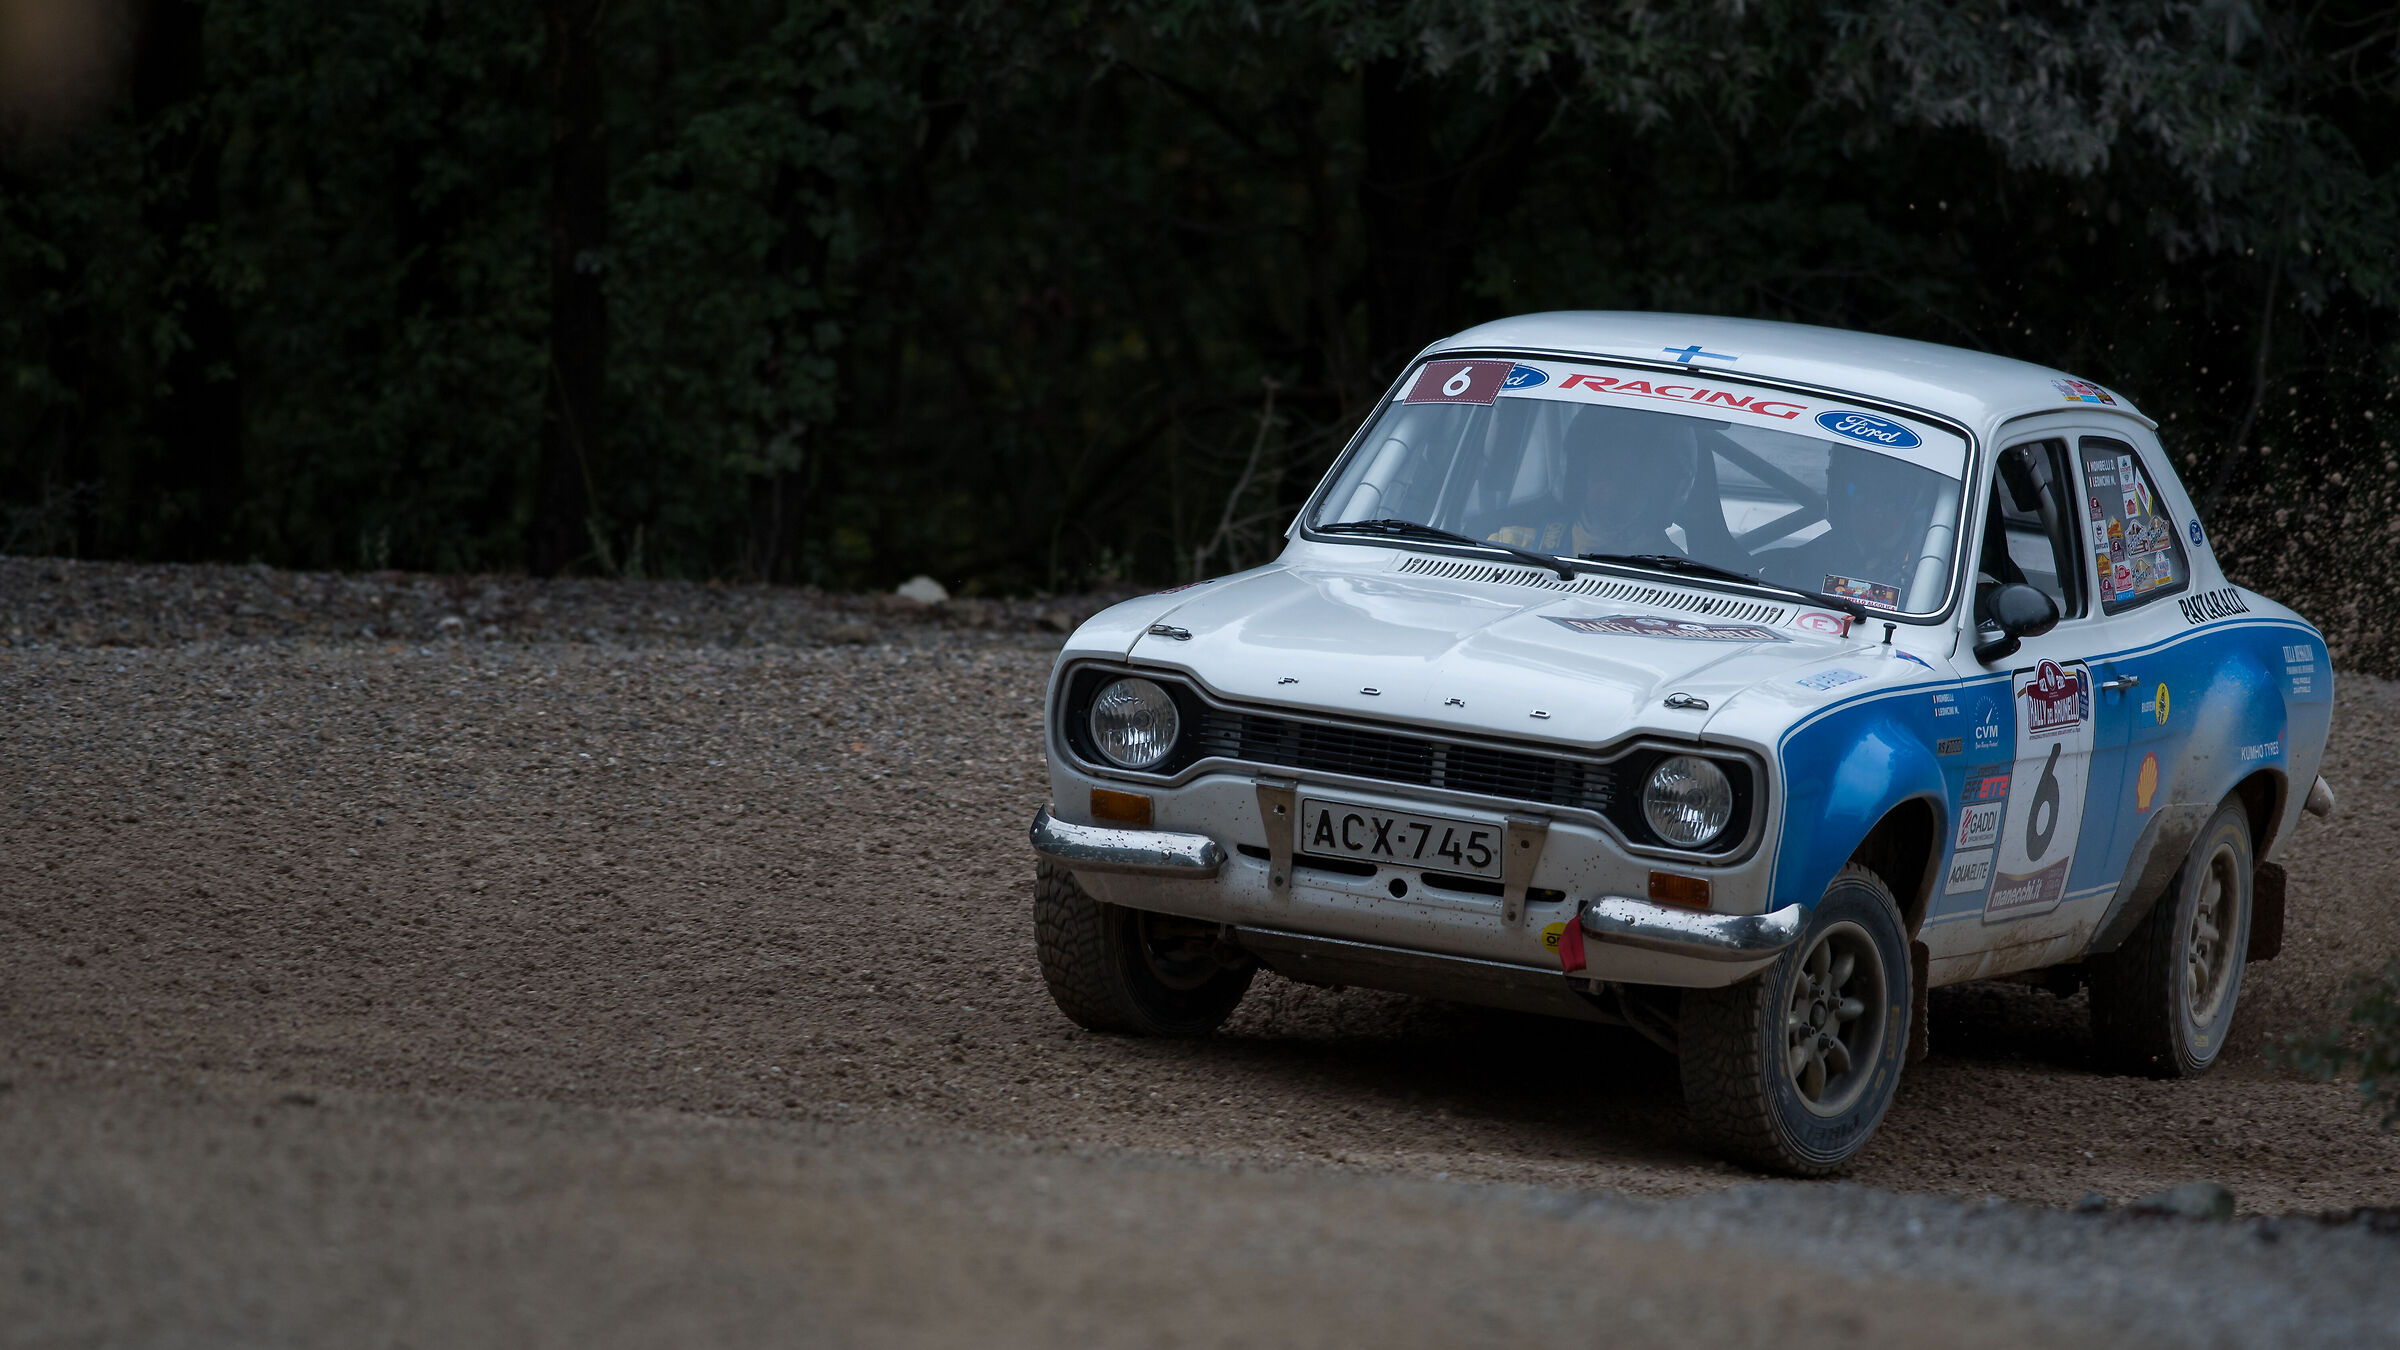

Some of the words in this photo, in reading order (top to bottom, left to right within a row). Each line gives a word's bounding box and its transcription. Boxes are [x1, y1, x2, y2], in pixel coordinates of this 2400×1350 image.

[1442, 366, 1473, 397] 6
[1559, 373, 1808, 420] RACING
[1835, 415, 1902, 444] Ford
[1567, 620, 1640, 635] RALLY
[1666, 629, 1774, 640] BRUNELLO
[1812, 618, 1828, 631] E
[2028, 694, 2047, 727] RALLY
[2054, 691, 2079, 724] BRUNELLO
[1975, 725, 1998, 739] CVM
[2241, 744, 2263, 760] KUMHO
[2264, 741, 2279, 756] TYRES
[2026, 742, 2062, 862] 6
[1970, 810, 1998, 834] GADDI
[1313, 809, 1492, 868] ACX-745
[1949, 862, 1989, 884] AQUAELITE
[1992, 878, 2043, 907] manecchi.it
